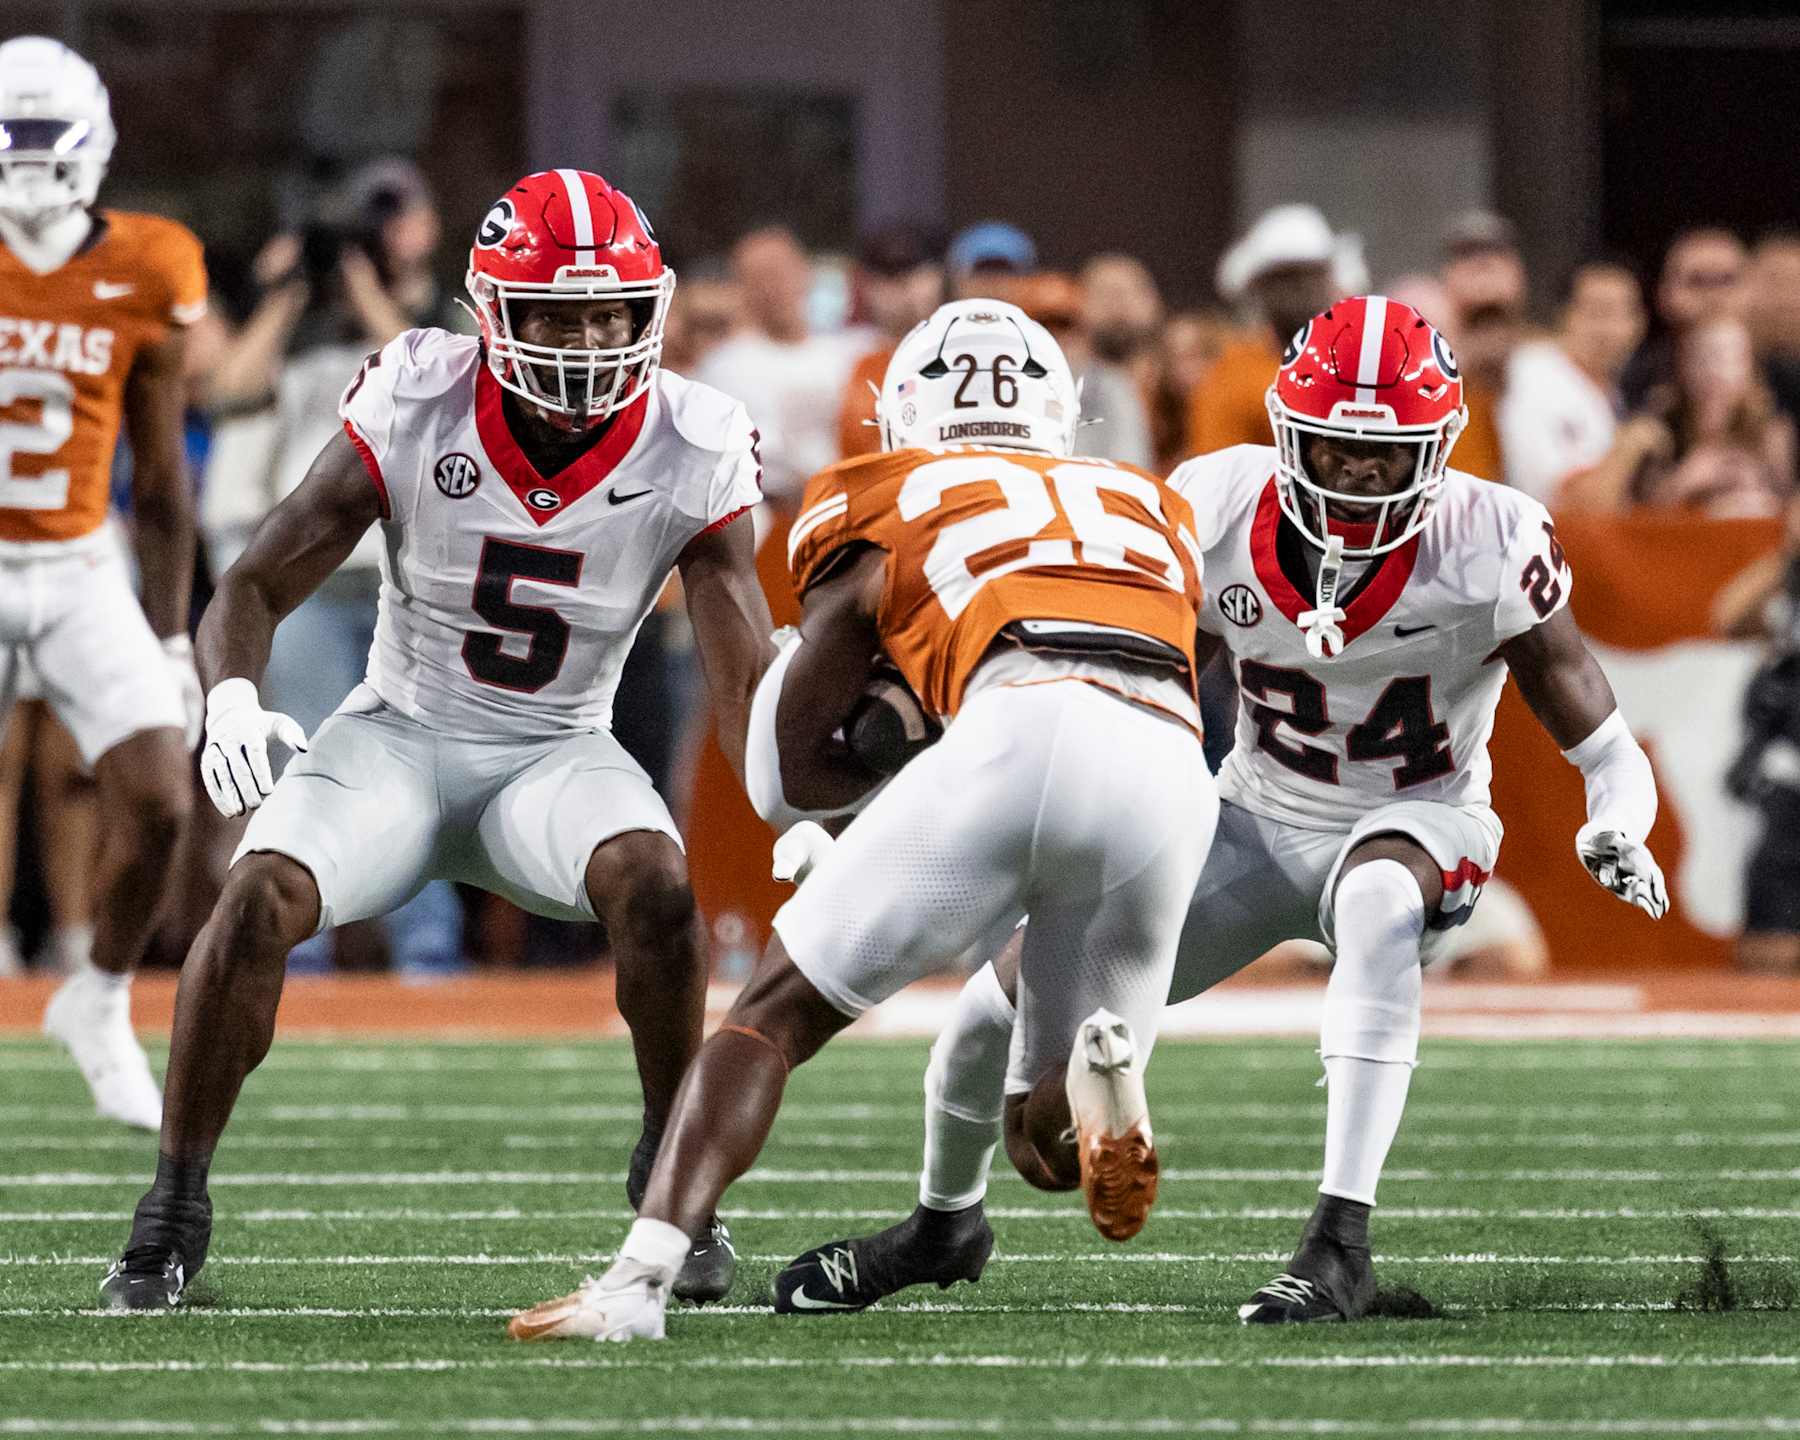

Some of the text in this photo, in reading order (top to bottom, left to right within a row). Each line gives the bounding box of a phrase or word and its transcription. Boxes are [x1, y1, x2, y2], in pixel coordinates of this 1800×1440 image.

[0, 316, 114, 375] EXAS
[953, 353, 1019, 409] 26
[939, 421, 1031, 442] LONGHORNS
[436, 455, 478, 496] SEC
[897, 456, 1185, 622] 26
[461, 535, 585, 694] 5
[1220, 586, 1260, 625] SEC
[1239, 657, 1457, 791] 24
